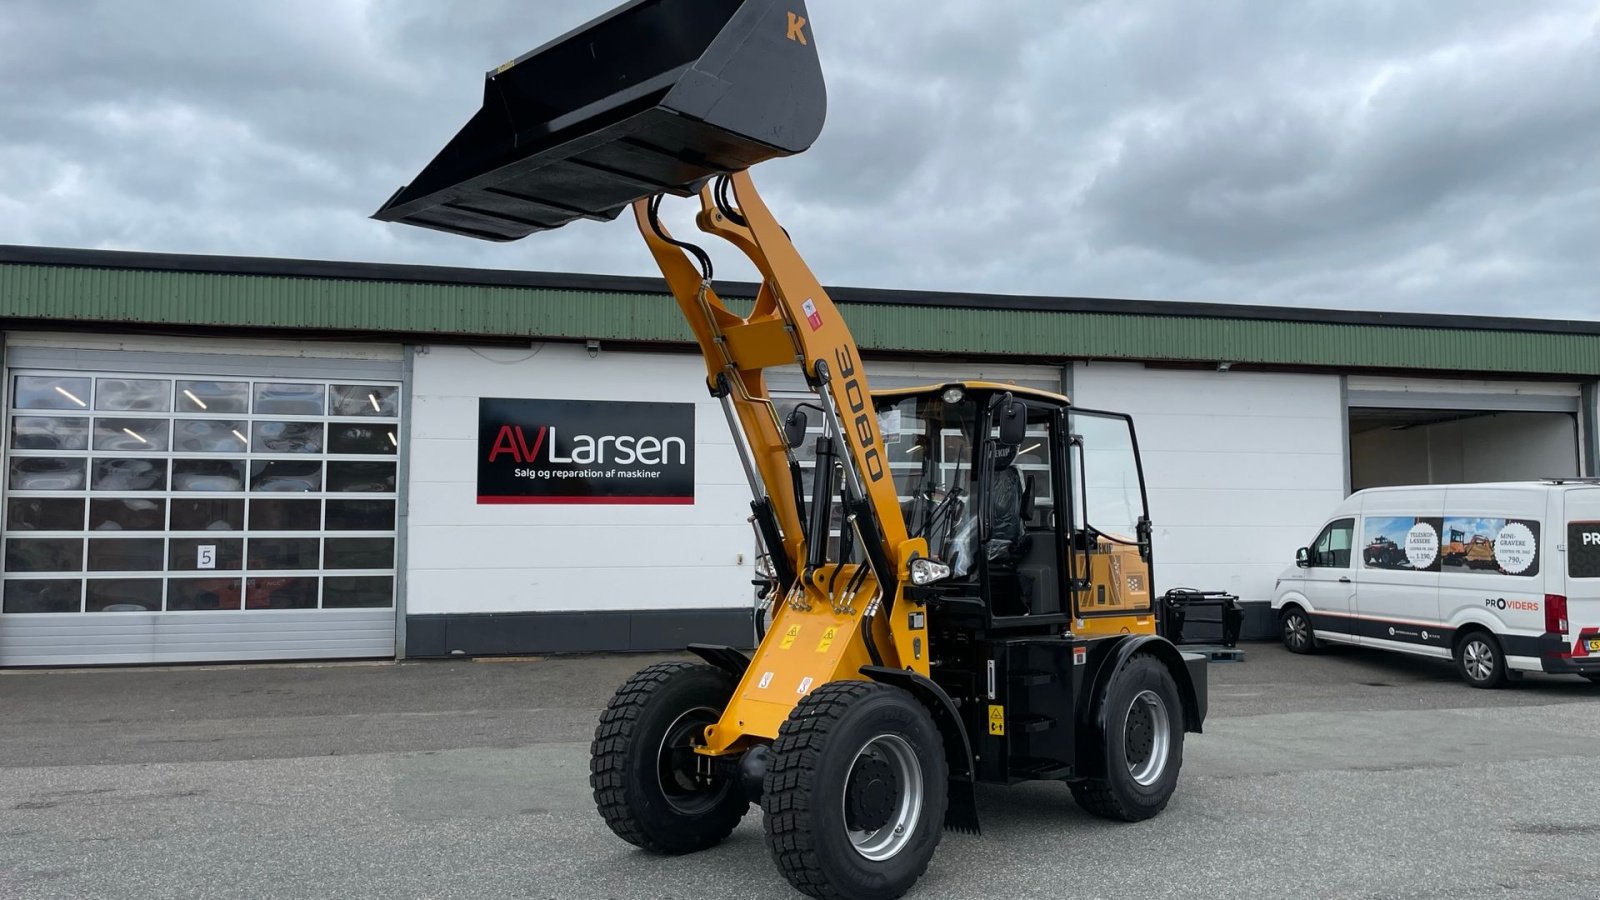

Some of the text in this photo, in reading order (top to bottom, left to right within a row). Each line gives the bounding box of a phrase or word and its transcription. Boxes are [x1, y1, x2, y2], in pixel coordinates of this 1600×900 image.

[786, 11, 807, 46] K
[835, 344, 884, 483] 3080
[514, 468, 661, 480] Salg og reparation af maskiner
[202, 550, 212, 565] 5
[1485, 597, 1539, 611] PROVIDERS
